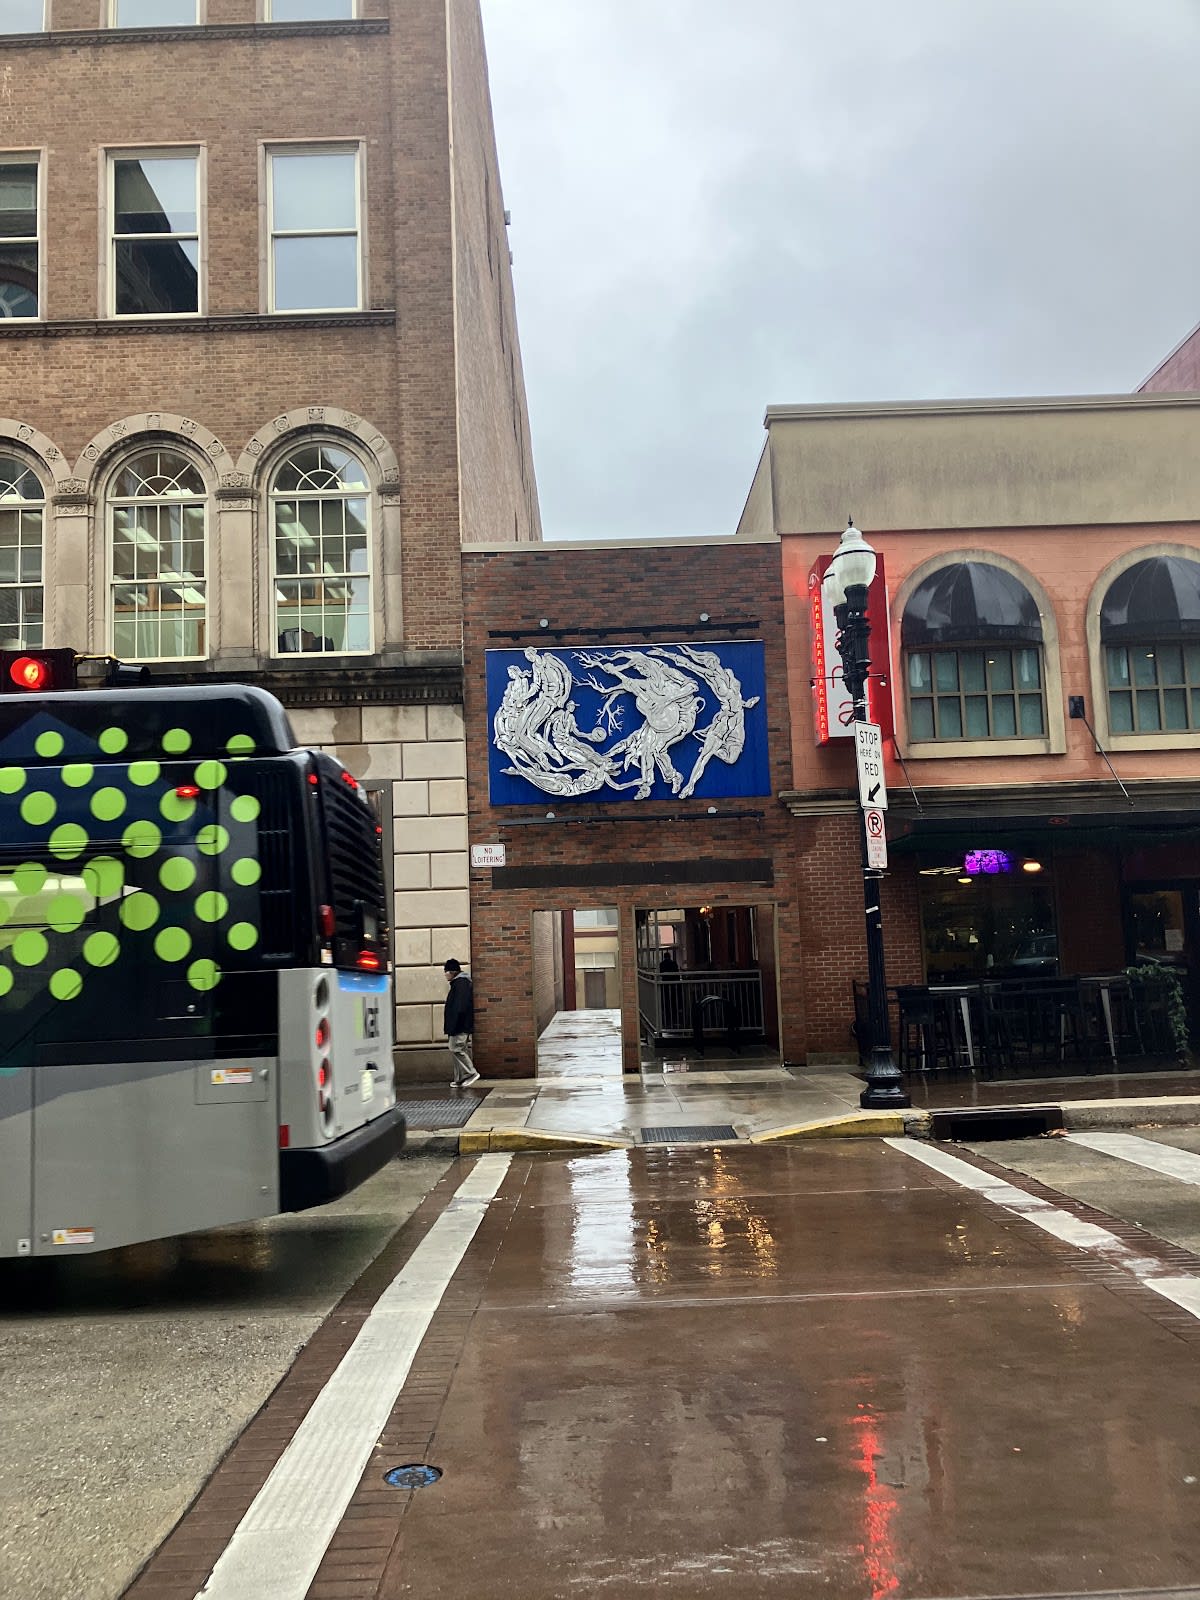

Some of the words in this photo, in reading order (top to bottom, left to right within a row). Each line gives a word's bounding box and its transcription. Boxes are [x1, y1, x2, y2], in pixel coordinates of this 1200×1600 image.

[859, 730, 878, 745] STOP
[860, 748, 872, 758] HERE
[864, 762, 879, 776] RED
[474, 855, 503, 863] LOITERING
